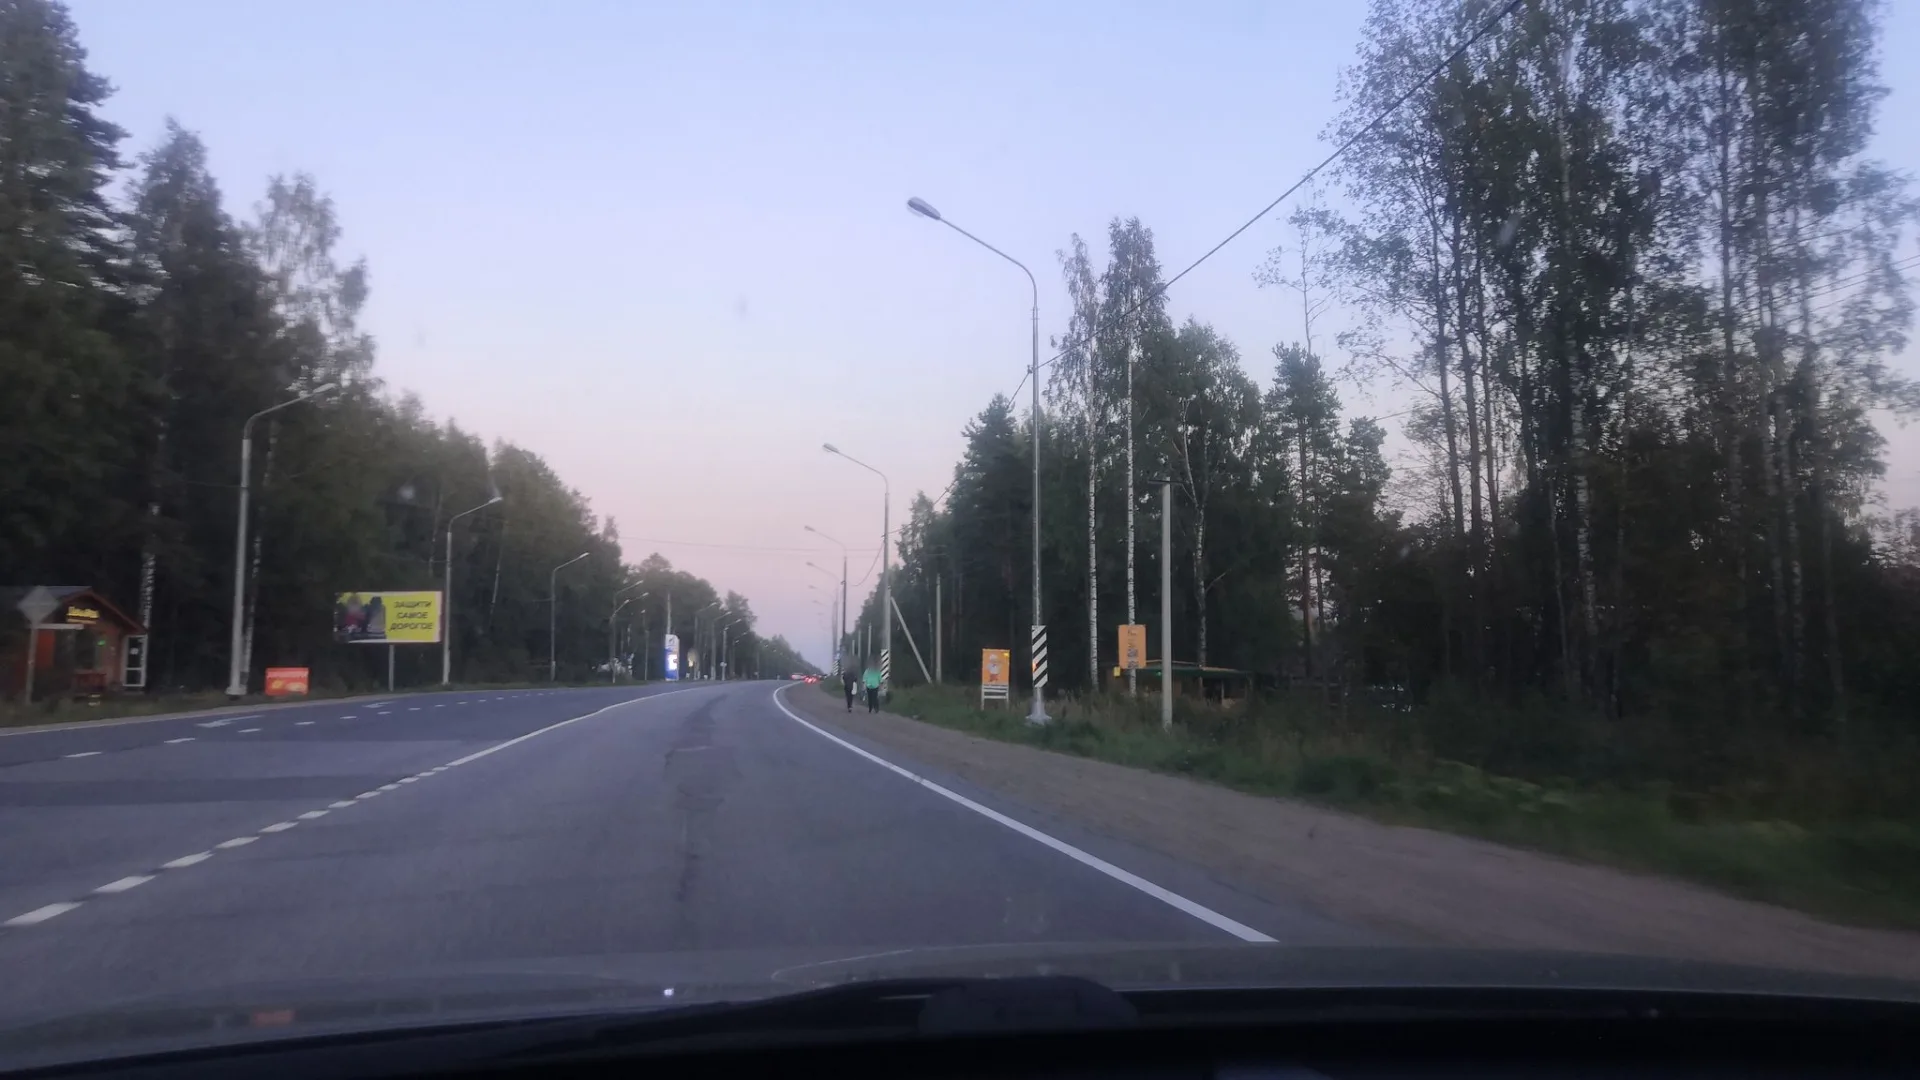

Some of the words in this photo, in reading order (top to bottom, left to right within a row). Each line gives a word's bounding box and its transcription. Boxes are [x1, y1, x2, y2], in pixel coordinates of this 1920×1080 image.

[393, 600, 432, 609] ЗАЩИТИ
[396, 611, 429, 619] САМОЕ
[389, 622, 433, 631] ДОРОГОЕ
